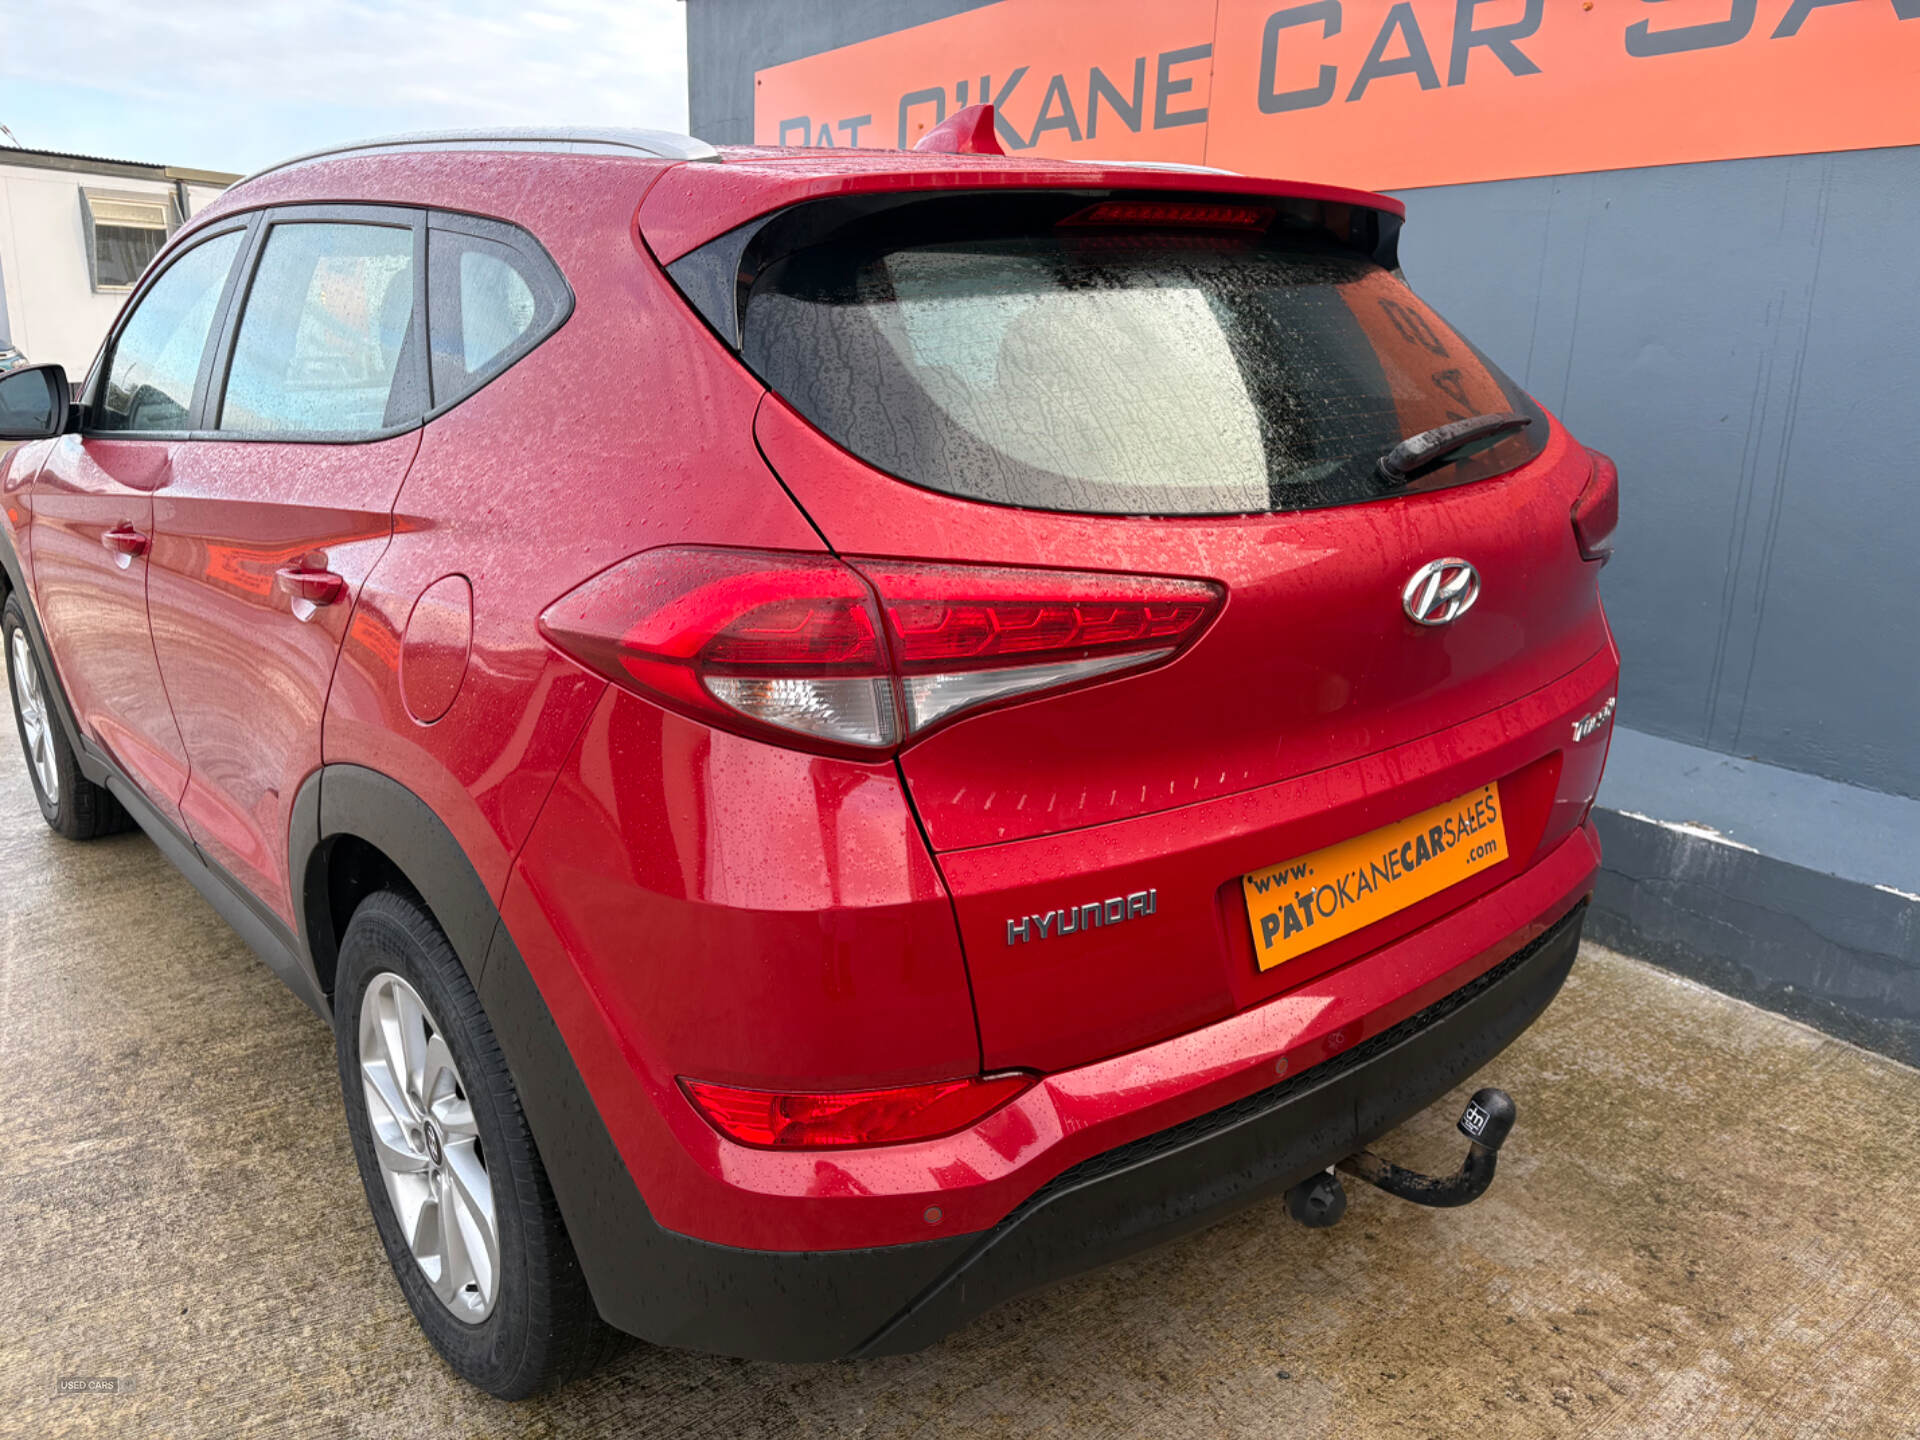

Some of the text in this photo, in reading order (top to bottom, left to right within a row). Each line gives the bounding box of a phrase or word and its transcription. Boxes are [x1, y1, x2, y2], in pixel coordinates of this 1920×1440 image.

[1257, 0, 1542, 115] CAR
[1466, 840, 1497, 865] .com
[1253, 863, 1314, 895] www.
[1006, 888, 1157, 946] HYUNDAI
